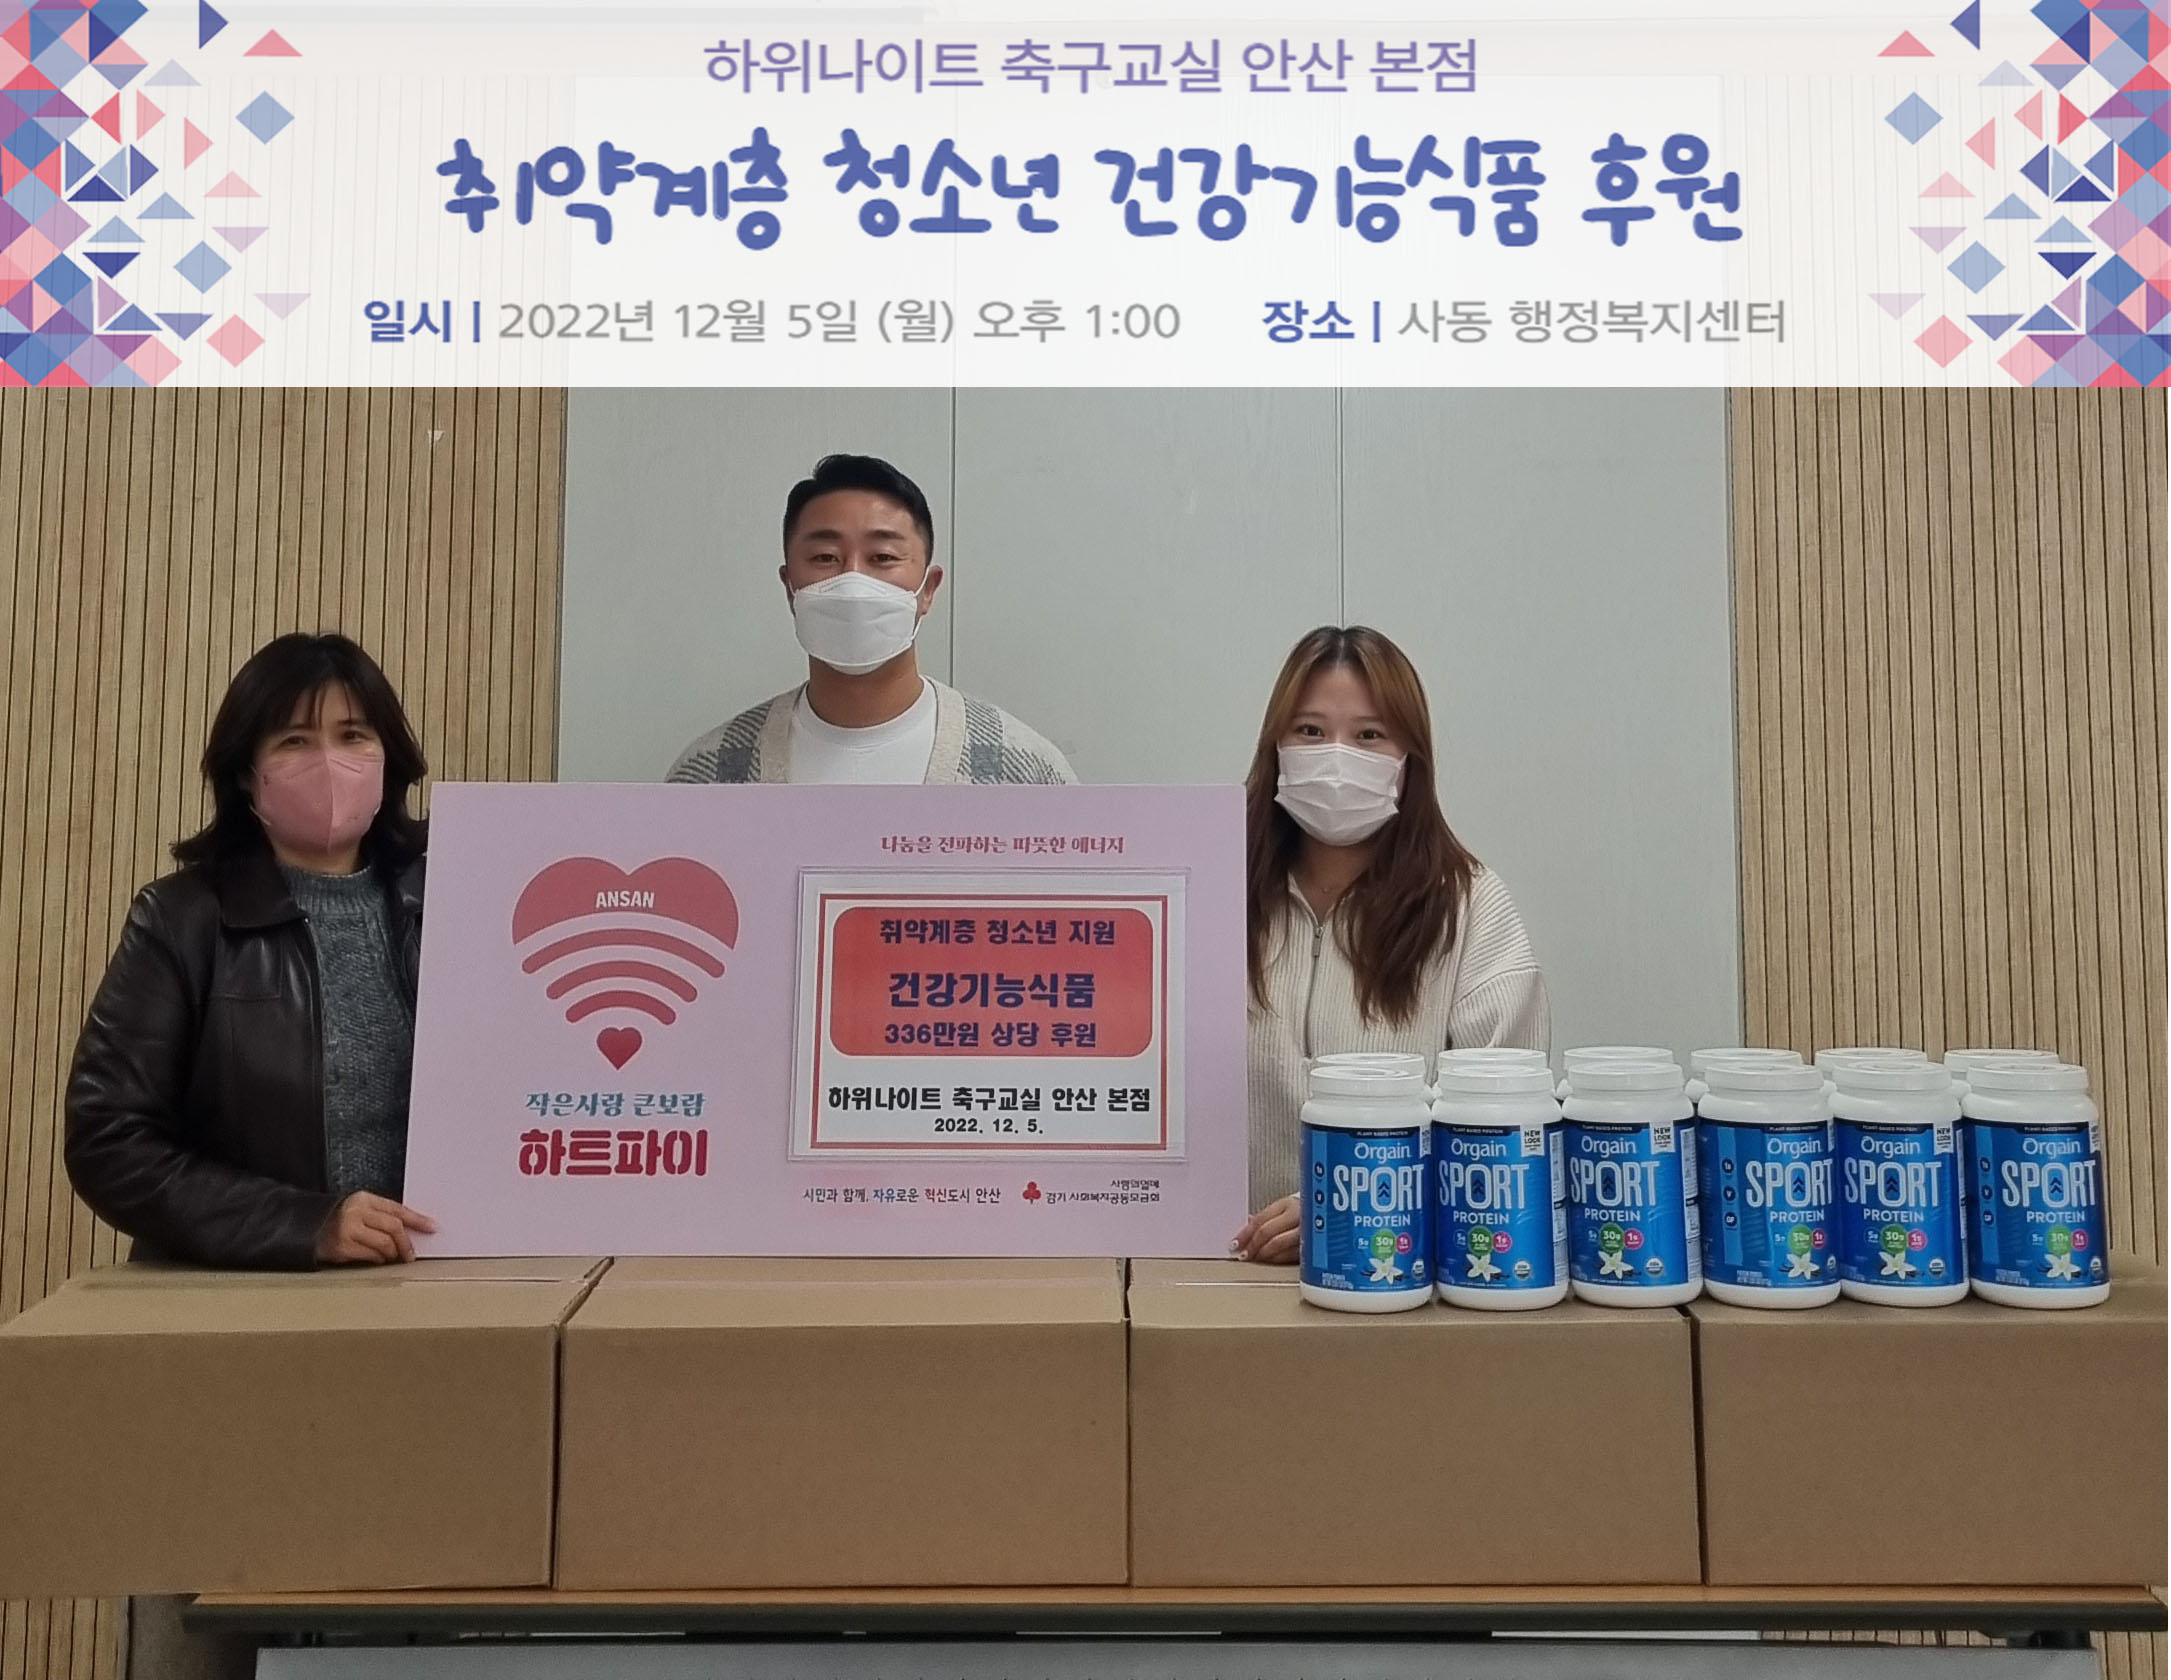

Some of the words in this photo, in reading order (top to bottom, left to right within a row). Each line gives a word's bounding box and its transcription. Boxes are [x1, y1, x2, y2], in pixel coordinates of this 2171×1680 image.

[880, 835, 932, 854] 나눔을
[937, 835, 1008, 854] 전파하는
[1012, 835, 1067, 854] 따뜻한
[595, 890, 655, 909] ANSAN
[879, 919, 977, 944] 취약계층
[986, 919, 1058, 944] 청소년
[1069, 919, 1116, 945] 지원
[887, 972, 1096, 1009] 건강기능식품
[884, 1023, 980, 1048] 336만원
[990, 1022, 1039, 1048] 상당
[1050, 1023, 1097, 1048] 후원
[525, 1091, 624, 1117] 작은사랑
[633, 1092, 707, 1117] 큰보람
[828, 1087, 942, 1112] 하위나이트
[951, 1087, 1041, 1112] 축구교실
[1051, 1087, 1098, 1112] 안산
[1106, 1087, 1151, 1112] 본점
[934, 1118, 984, 1134] 2022.
[992, 1118, 1019, 1134] 12.
[1026, 1118, 1044, 1134] 5.
[1654, 1127, 1670, 1135] NEW
[518, 1129, 709, 1177] 하트파이
[1354, 1142, 1412, 1163] Orgain
[1450, 1138, 1507, 1160] Orgain
[1581, 1135, 1637, 1158] Orgain
[1767, 1138, 1821, 1159] Orgain
[1861, 1135, 1921, 1158] Orgain
[2022, 1138, 2080, 1159] Orgain
[1333, 1164, 1424, 1212] SPORT
[1438, 1159, 1529, 1209] SPORT
[1570, 1156, 1660, 1207] SPORT
[1745, 1159, 1832, 1208] SPORT
[1844, 1157, 1942, 1208] SPORT
[2001, 1159, 2096, 1208] SPORT
[803, 1188, 838, 1203] 시민과
[873, 1188, 919, 1203] 자유로운
[924, 1188, 970, 1203] 혁신도시
[976, 1188, 1001, 1203] 안산
[1354, 1215, 1410, 1227] PROTEIN
[1453, 1211, 1510, 1225] PROTEIN
[1584, 1207, 1641, 1222] PROTEIN
[1769, 1209, 1824, 1223] PROTEIN
[1863, 1209, 1924, 1223] PROTEIN
[2026, 1211, 2085, 1223] PROTEIN
